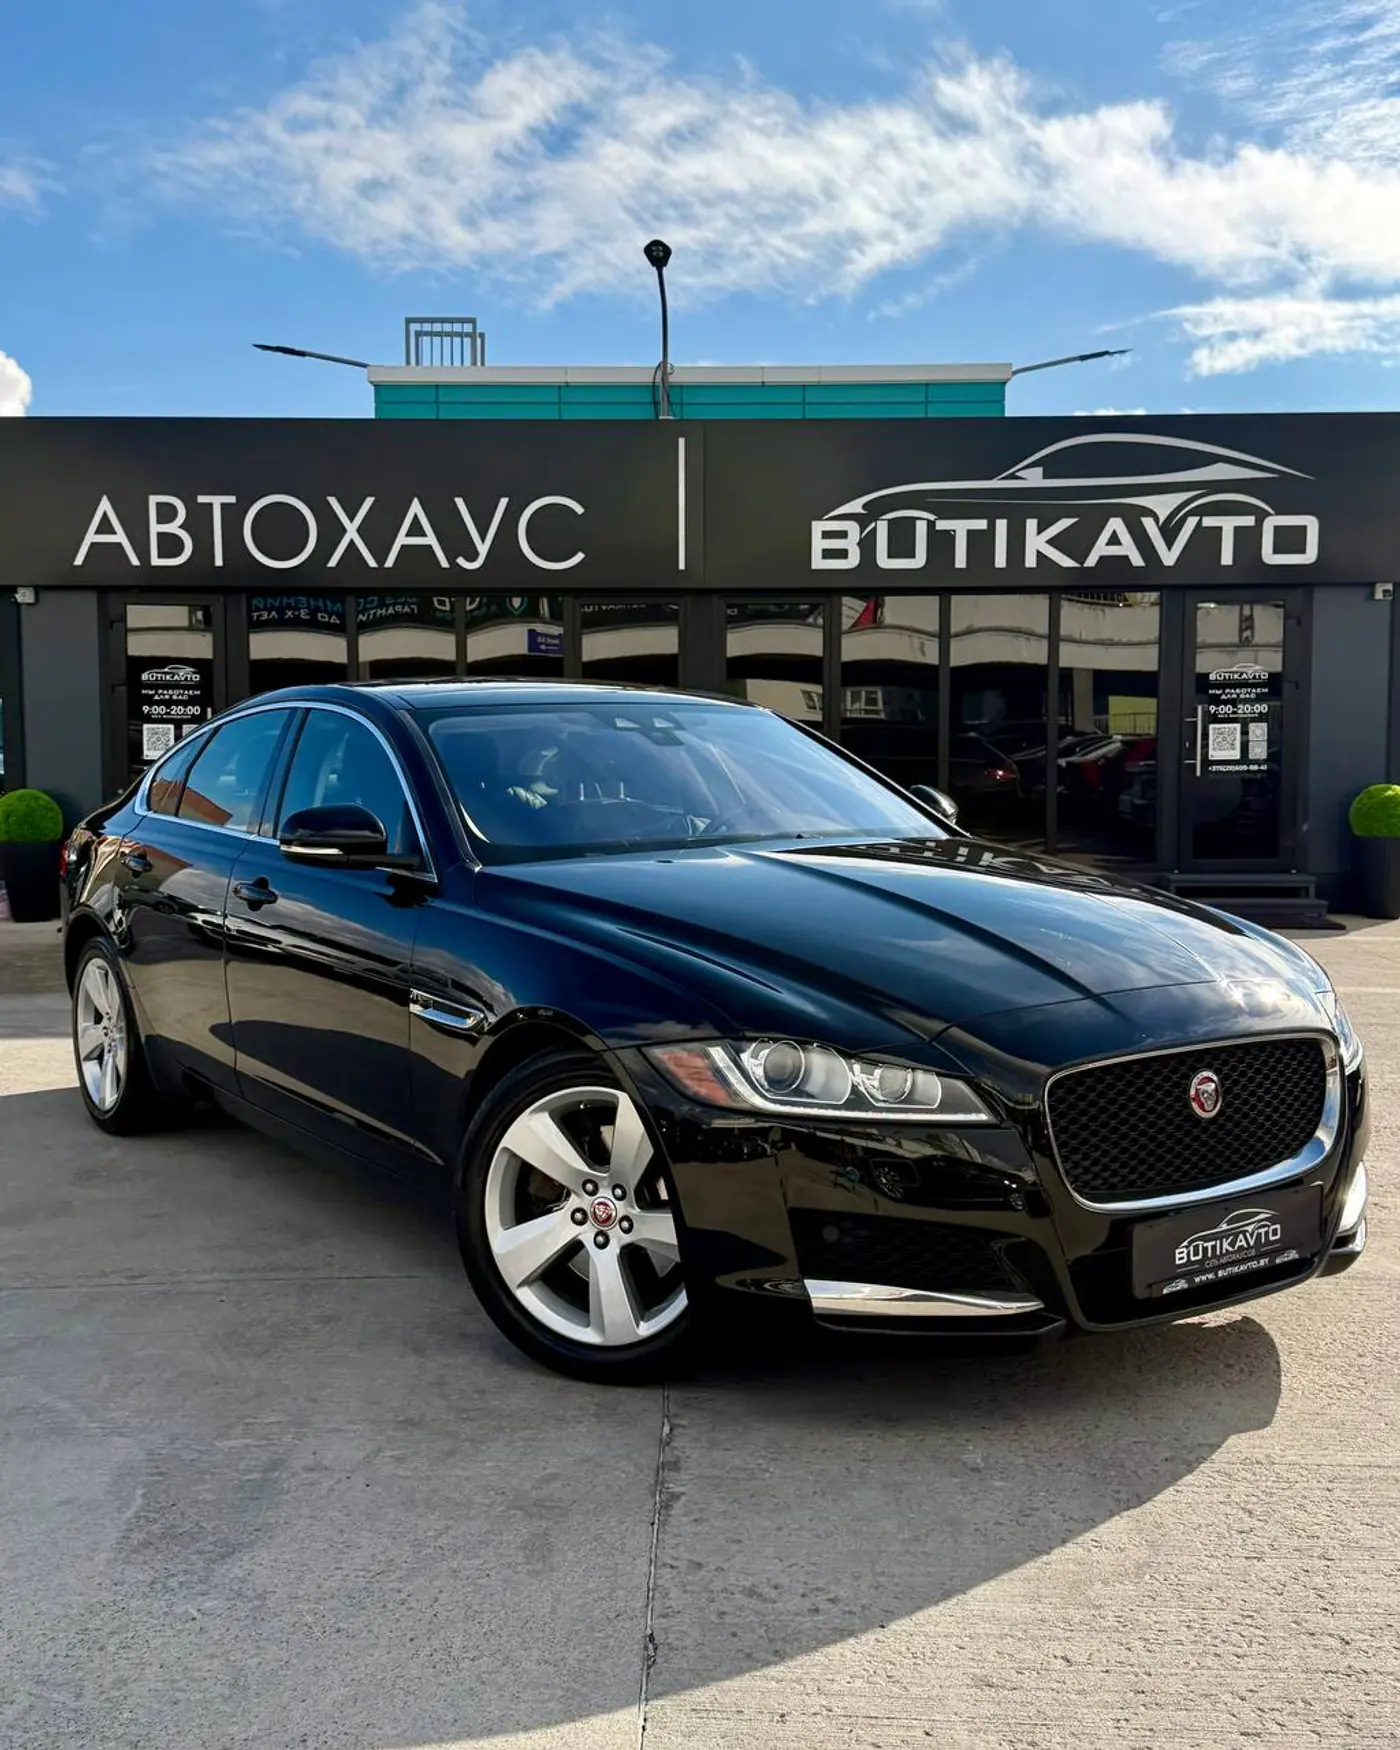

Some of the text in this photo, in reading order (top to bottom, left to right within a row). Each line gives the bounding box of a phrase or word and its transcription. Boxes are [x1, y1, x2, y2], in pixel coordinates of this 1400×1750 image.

[73, 494, 586, 569] АВТОХАУС
[811, 514, 1319, 569] BUTIKAVTO
[141, 672, 200, 681] BUTIKAVTO
[1208, 672, 1269, 681] BUTIKAVTO
[142, 705, 201, 715] 9:00-20:00
[1208, 704, 1269, 714] 9:00-20:00
[1175, 1224, 1281, 1265] BUTIKAVTO
